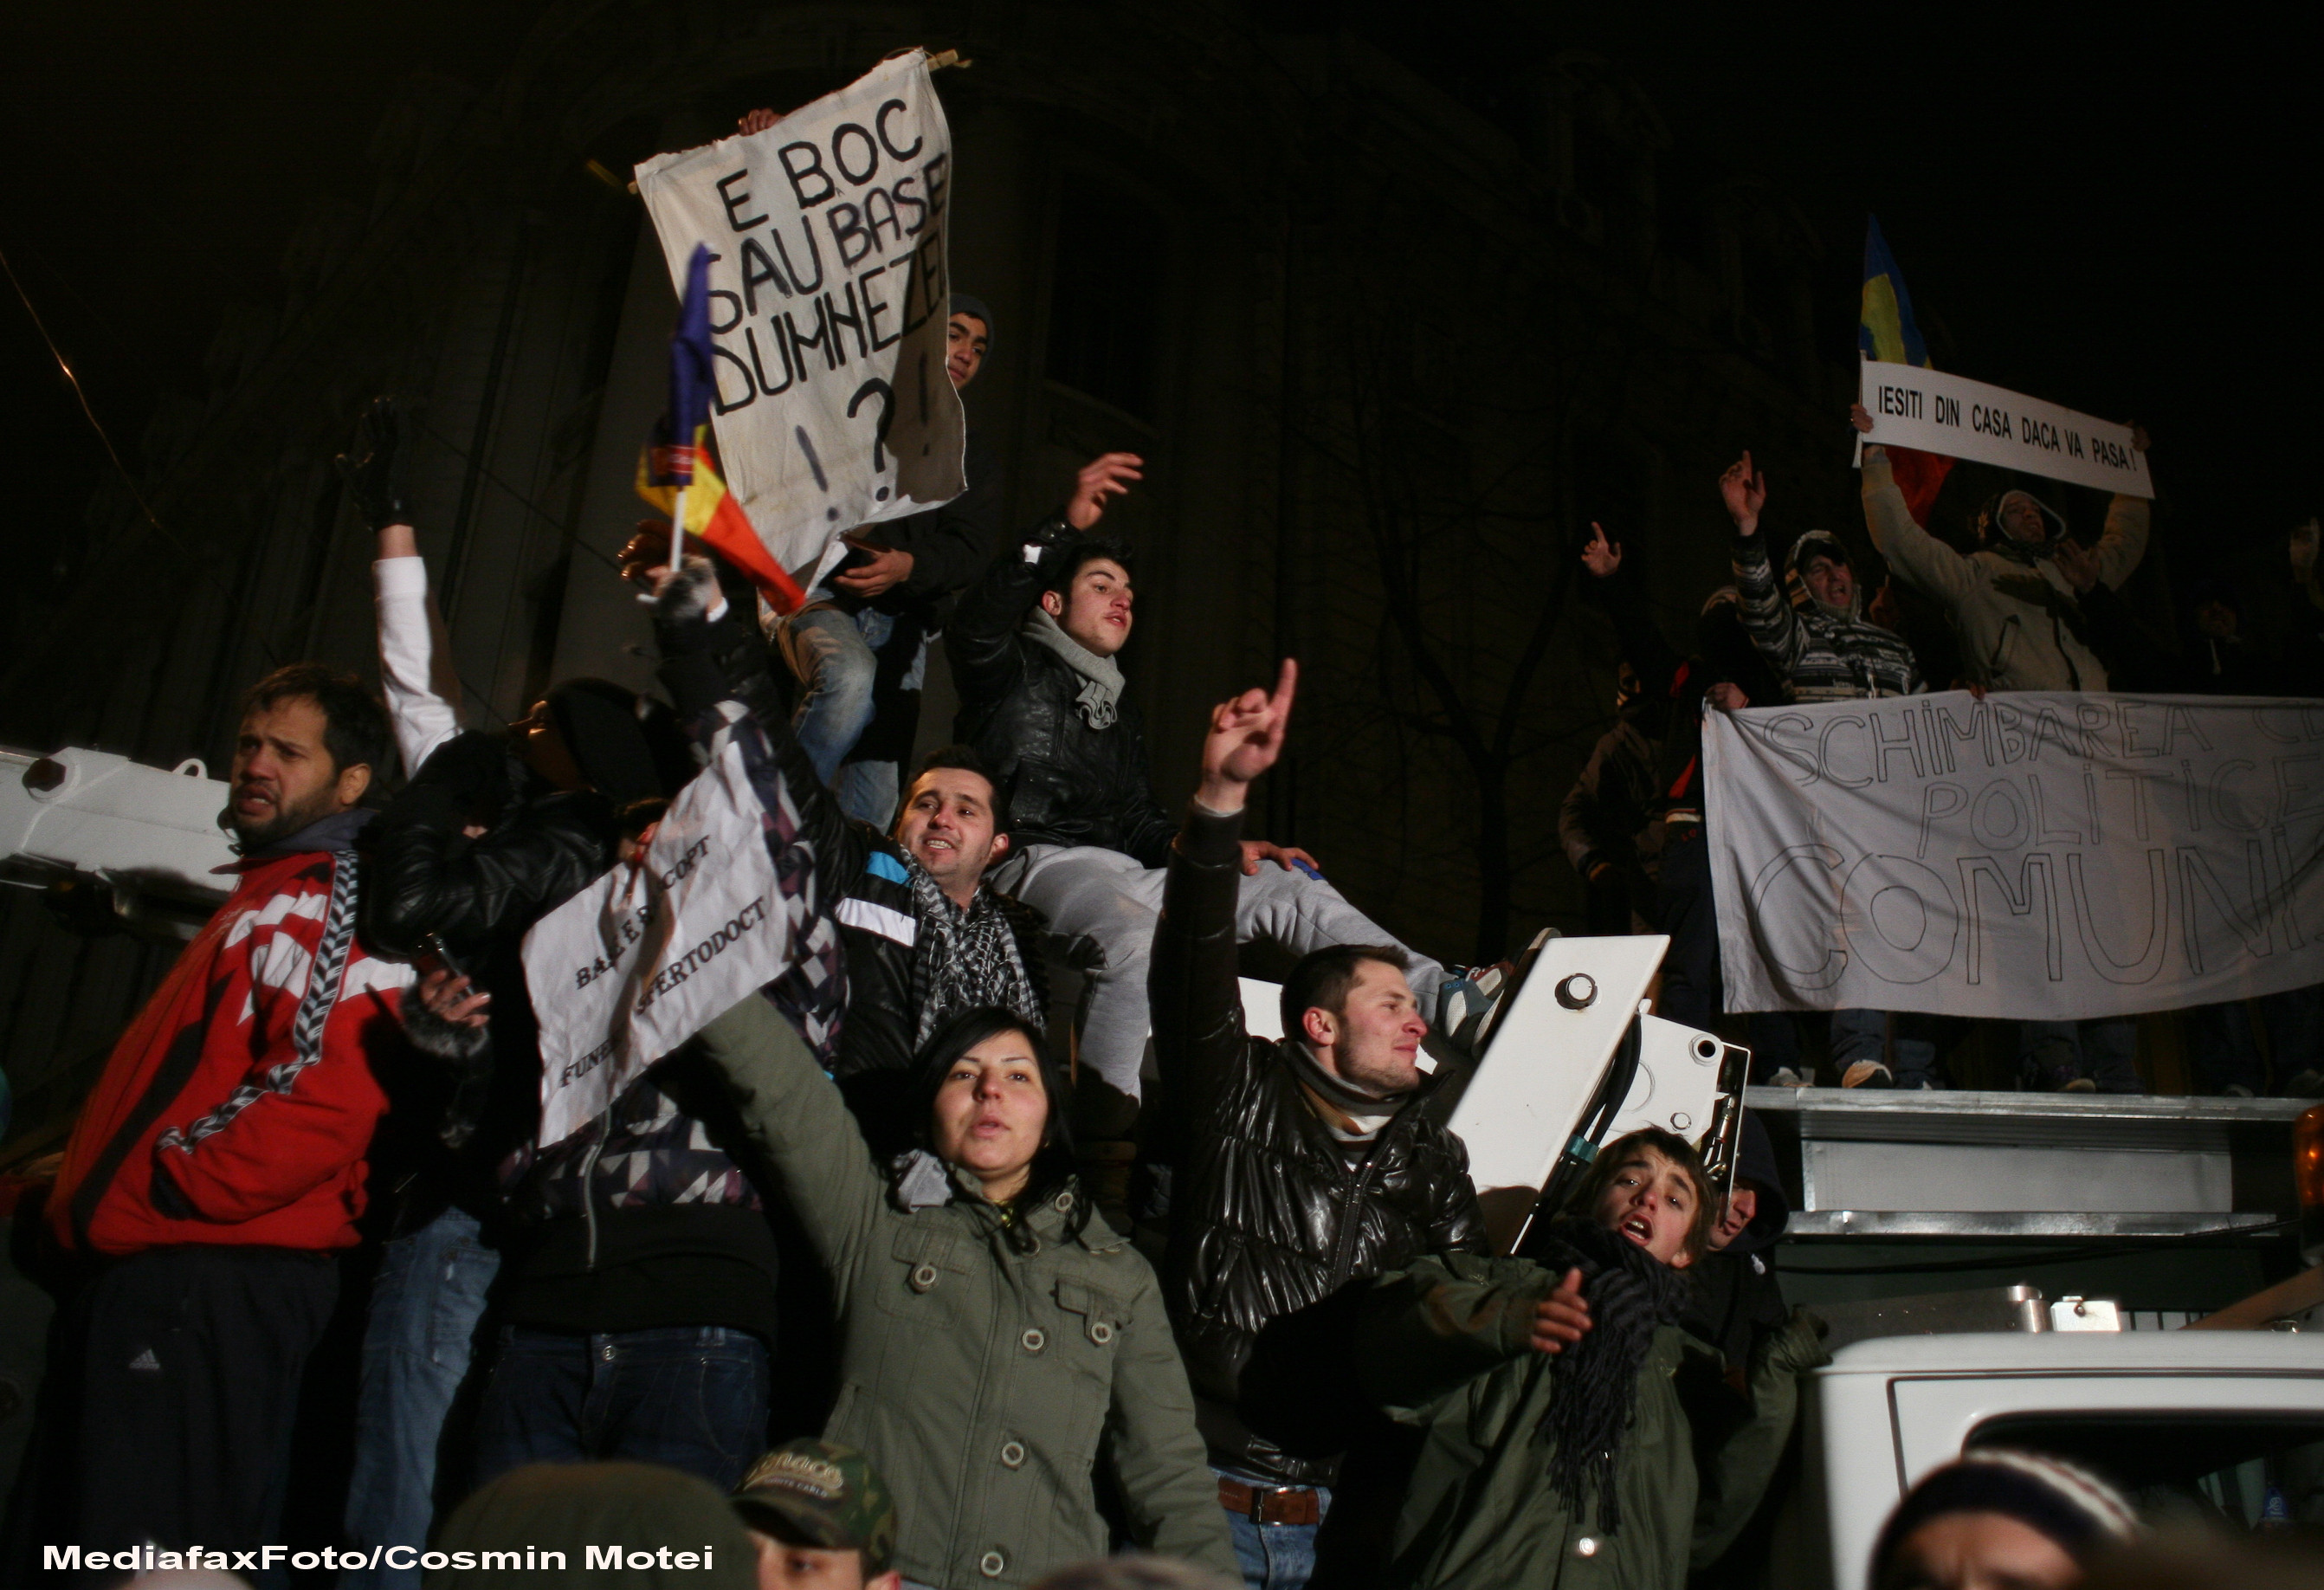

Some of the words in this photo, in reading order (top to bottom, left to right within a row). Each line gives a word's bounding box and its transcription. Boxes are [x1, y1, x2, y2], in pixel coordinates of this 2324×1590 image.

[717, 169, 769, 232] E
[778, 99, 923, 210] BOC
[826, 152, 946, 267] BASE
[1879, 385, 1922, 420] IESITI
[1935, 395, 1959, 427] DIN
[1972, 404, 2011, 440] CASA
[2022, 416, 2061, 452] DACA
[2065, 429, 2084, 459] VA
[1749, 825, 2324, 990] COMUNI
